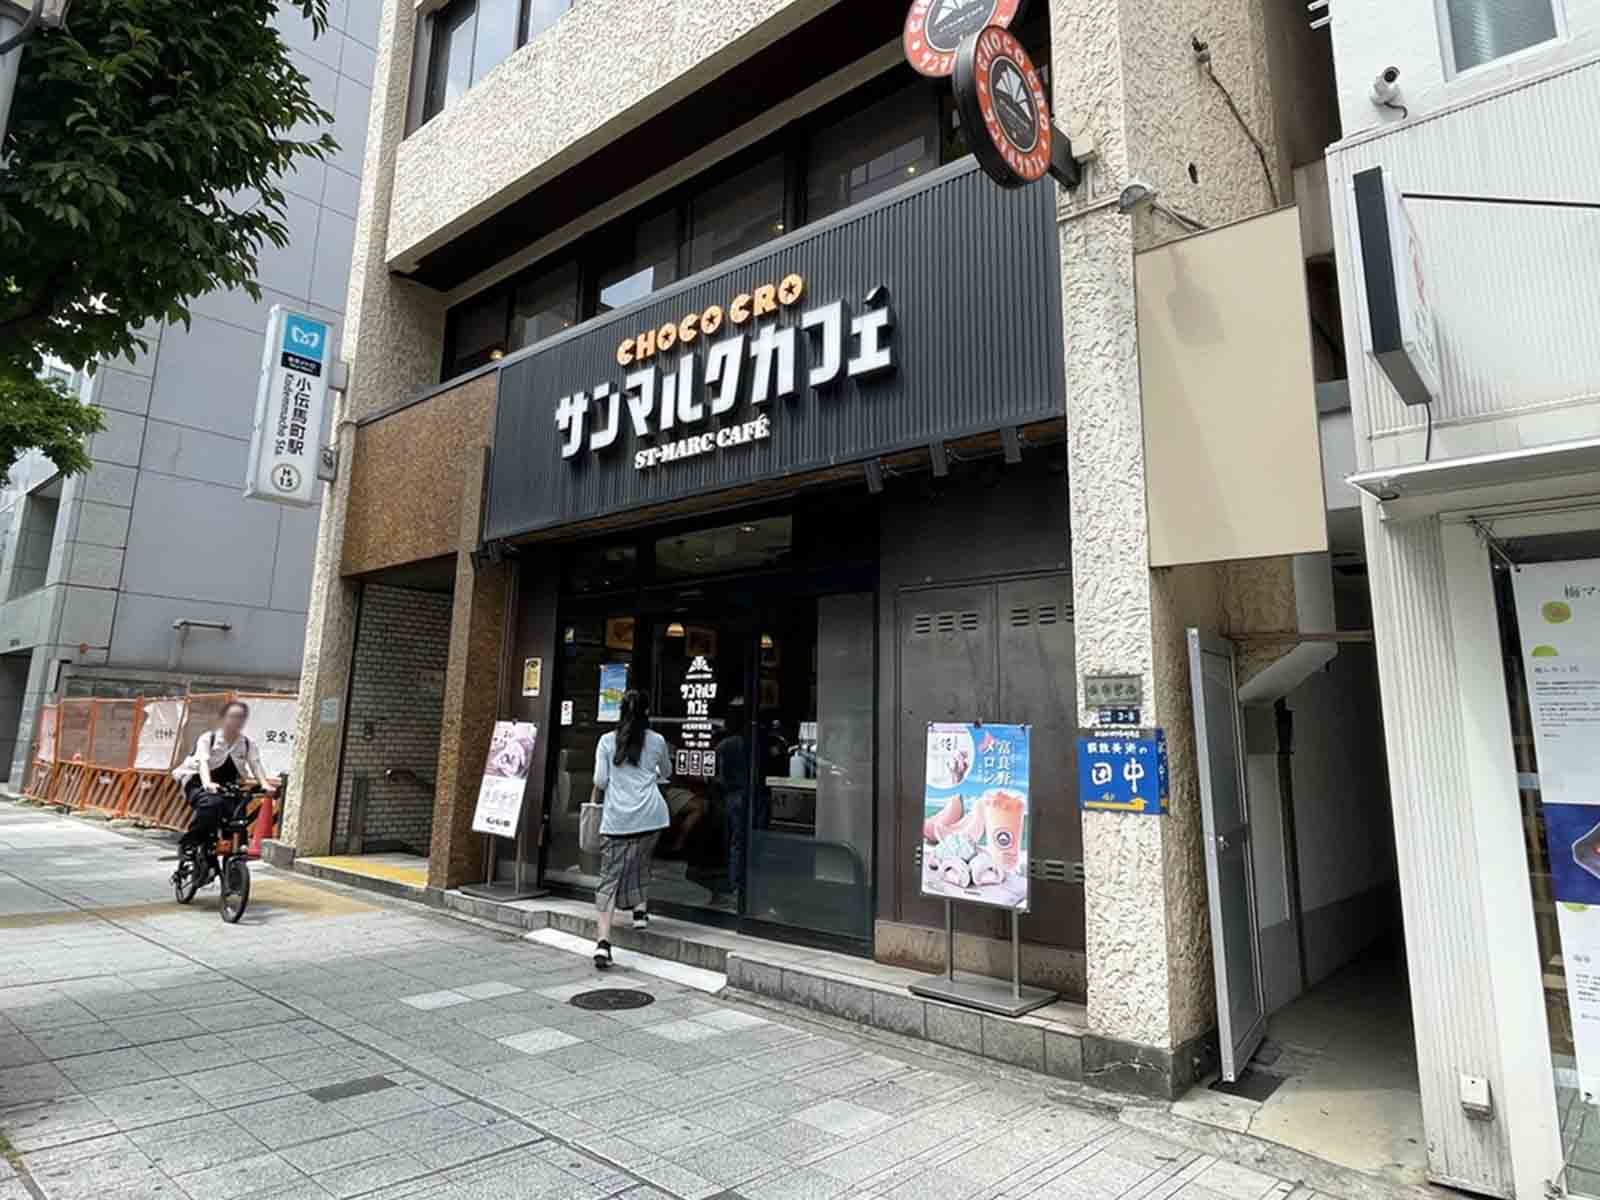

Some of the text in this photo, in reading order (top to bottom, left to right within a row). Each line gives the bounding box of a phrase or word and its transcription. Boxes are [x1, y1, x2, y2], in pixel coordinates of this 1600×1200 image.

[616, 272, 805, 366] CHOCO CRO
[554, 285, 898, 460] サンマルクカフェ
[287, 377, 312, 456] 小伝馬町駅
[634, 413, 770, 469] ST-MARC CAFÉ
